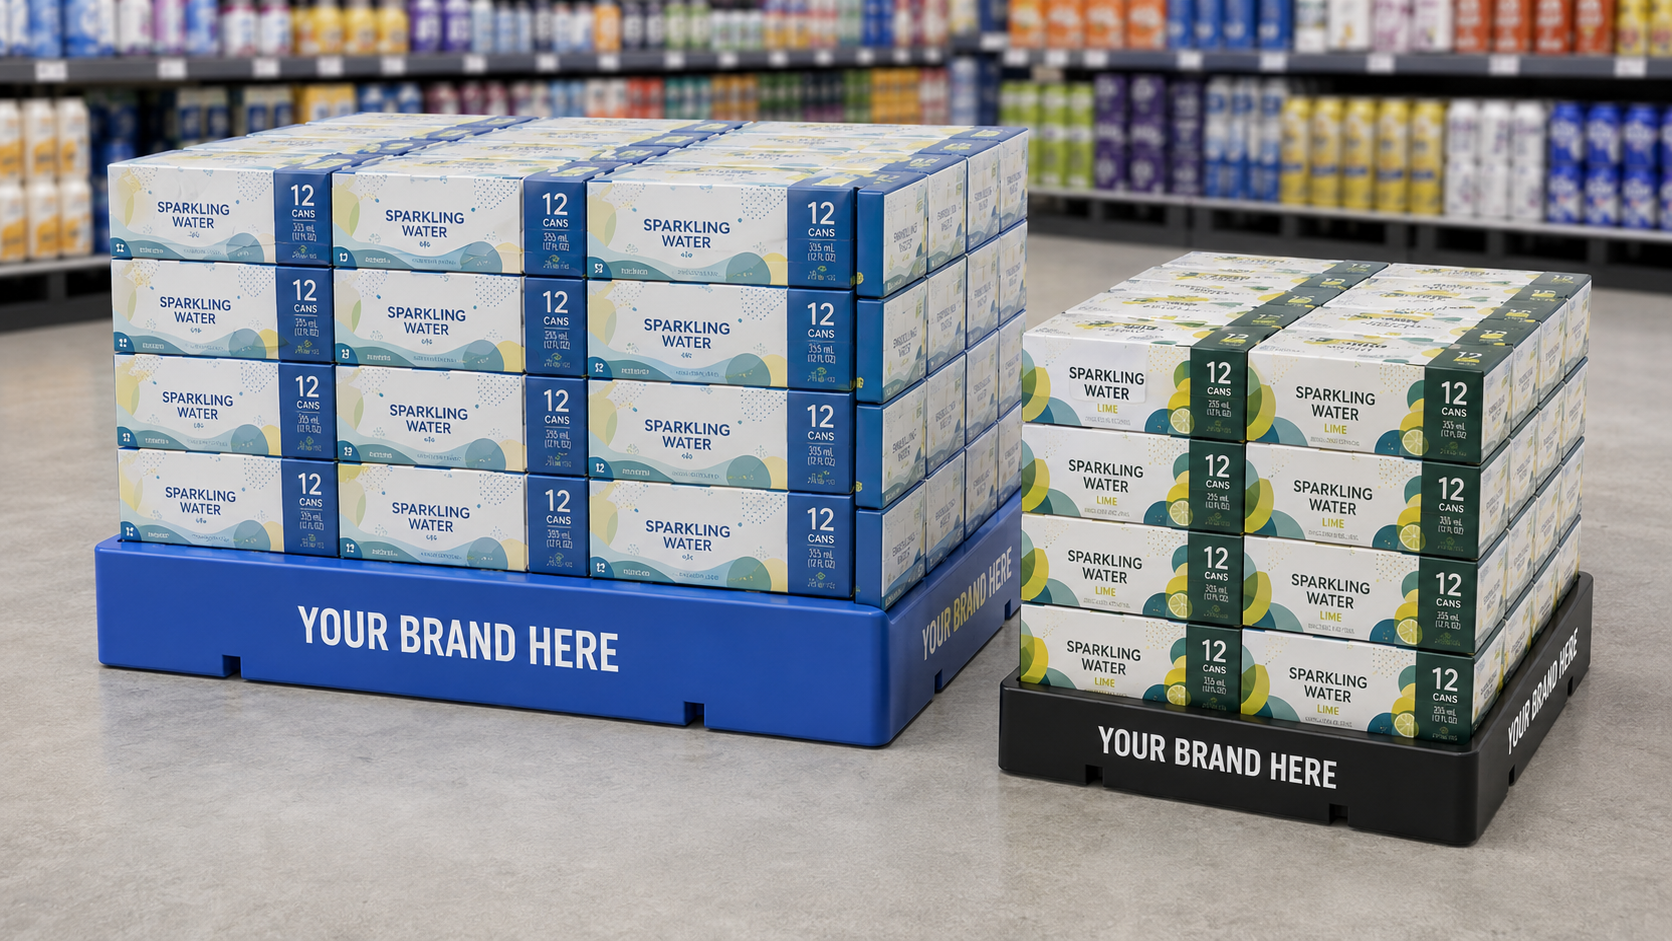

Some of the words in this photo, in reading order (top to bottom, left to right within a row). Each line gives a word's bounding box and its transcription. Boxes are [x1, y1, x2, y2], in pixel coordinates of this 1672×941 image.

[291, 184, 315, 206] 12
[157, 201, 230, 216] SPARKLING
[542, 192, 568, 216] 12
[292, 209, 315, 218] CANS
[386, 209, 464, 224] SPARKLING
[808, 201, 835, 225] 12
[172, 216, 214, 229] WATER
[543, 218, 568, 228] CANS
[644, 218, 730, 234] SPARKLING
[402, 225, 447, 238] WATER
[808, 228, 835, 237] CANS
[662, 235, 711, 248] WATER
[293, 279, 317, 301] 12
[160, 296, 231, 311] SPARKLING
[294, 304, 317, 313] CANS
[543, 290, 568, 314] 12
[174, 311, 216, 325] WATER
[388, 306, 466, 322] SPARKLING
[543, 316, 569, 326] CANS
[807, 302, 834, 326] 12
[404, 322, 449, 336] WATER
[644, 318, 730, 335] SPARKLING
[808, 329, 835, 338] CANS
[662, 335, 711, 349] WATER
[1069, 366, 1144, 385] SPARKLING
[1207, 361, 1231, 384] 12
[295, 375, 319, 398] 12
[1084, 384, 1129, 400] WATER
[1207, 387, 1231, 396] CANS
[1441, 381, 1467, 405] 12
[162, 391, 233, 407] SPARKLING
[544, 389, 569, 412] 12
[1296, 386, 1375, 406] SPARKLING
[297, 400, 320, 410] CANS
[390, 404, 468, 420] SPARKLING
[1097, 404, 1119, 414] LIME
[1311, 404, 1359, 421] WATER
[1441, 407, 1467, 417] CANS
[177, 407, 218, 420] WATER
[544, 415, 570, 425] CANS
[807, 404, 834, 428] 12
[406, 420, 451, 434] WATER
[645, 419, 730, 436] SPARKLING
[1324, 423, 1348, 435] LIME
[662, 435, 711, 450] WATER
[808, 431, 834, 441] CANS
[1068, 459, 1143, 478] SPARKLING
[1205, 454, 1230, 478] 12
[298, 473, 322, 495] 12
[1083, 476, 1128, 493] WATER
[1206, 480, 1230, 490] CANS
[1293, 480, 1373, 501] SPARKLING
[1438, 477, 1464, 501] 12
[165, 486, 236, 503] SPARKLING
[299, 497, 322, 507] CANS
[545, 489, 570, 513] 12
[1096, 496, 1118, 506] LIME
[180, 502, 221, 516] WATER
[392, 502, 470, 519] SPARKLING
[1309, 498, 1356, 516] WATER
[1439, 503, 1464, 513] CANS
[408, 518, 453, 533] WATER
[546, 515, 571, 525] CANS
[807, 507, 834, 532] 12
[1322, 518, 1345, 529] LIME
[646, 520, 730, 538] SPARKLING
[663, 536, 712, 551] WATER
[808, 534, 834, 544] CANS
[1068, 549, 1142, 570] SPARKLING
[1204, 546, 1228, 570] 12
[1082, 567, 1127, 584] WATER
[1204, 571, 1228, 581] CANS
[1095, 586, 1117, 597] LIME
[1291, 573, 1370, 595] SPARKLING
[1436, 572, 1461, 597] 12
[922, 606, 951, 661] YOUR
[953, 570, 987, 633] BRAND
[988, 545, 1012, 598] HERE
[1306, 591, 1354, 609] WATER
[1436, 598, 1461, 608] CANS
[1320, 611, 1343, 622] LIME
[298, 605, 389, 651] YOUR
[400, 615, 515, 662] BRAND
[529, 626, 619, 672] HERE
[1067, 640, 1141, 661] SPARKLING
[1202, 639, 1226, 663] 12
[1081, 658, 1126, 675] WATER
[1203, 664, 1226, 674] CANS
[1094, 677, 1116, 688] LIME
[1289, 667, 1367, 689] SPARKLING
[1432, 667, 1458, 692] 12
[1304, 685, 1351, 703] WATER
[1433, 693, 1458, 703] CANS
[1508, 699, 1530, 755] YOUR
[1531, 660, 1558, 721] BRAND
[1559, 627, 1578, 679] HERE
[1317, 704, 1340, 715] LIME
[1098, 726, 1166, 763] YOUR
[1175, 737, 1261, 777] BRAND
[1270, 752, 1337, 789] HERE
